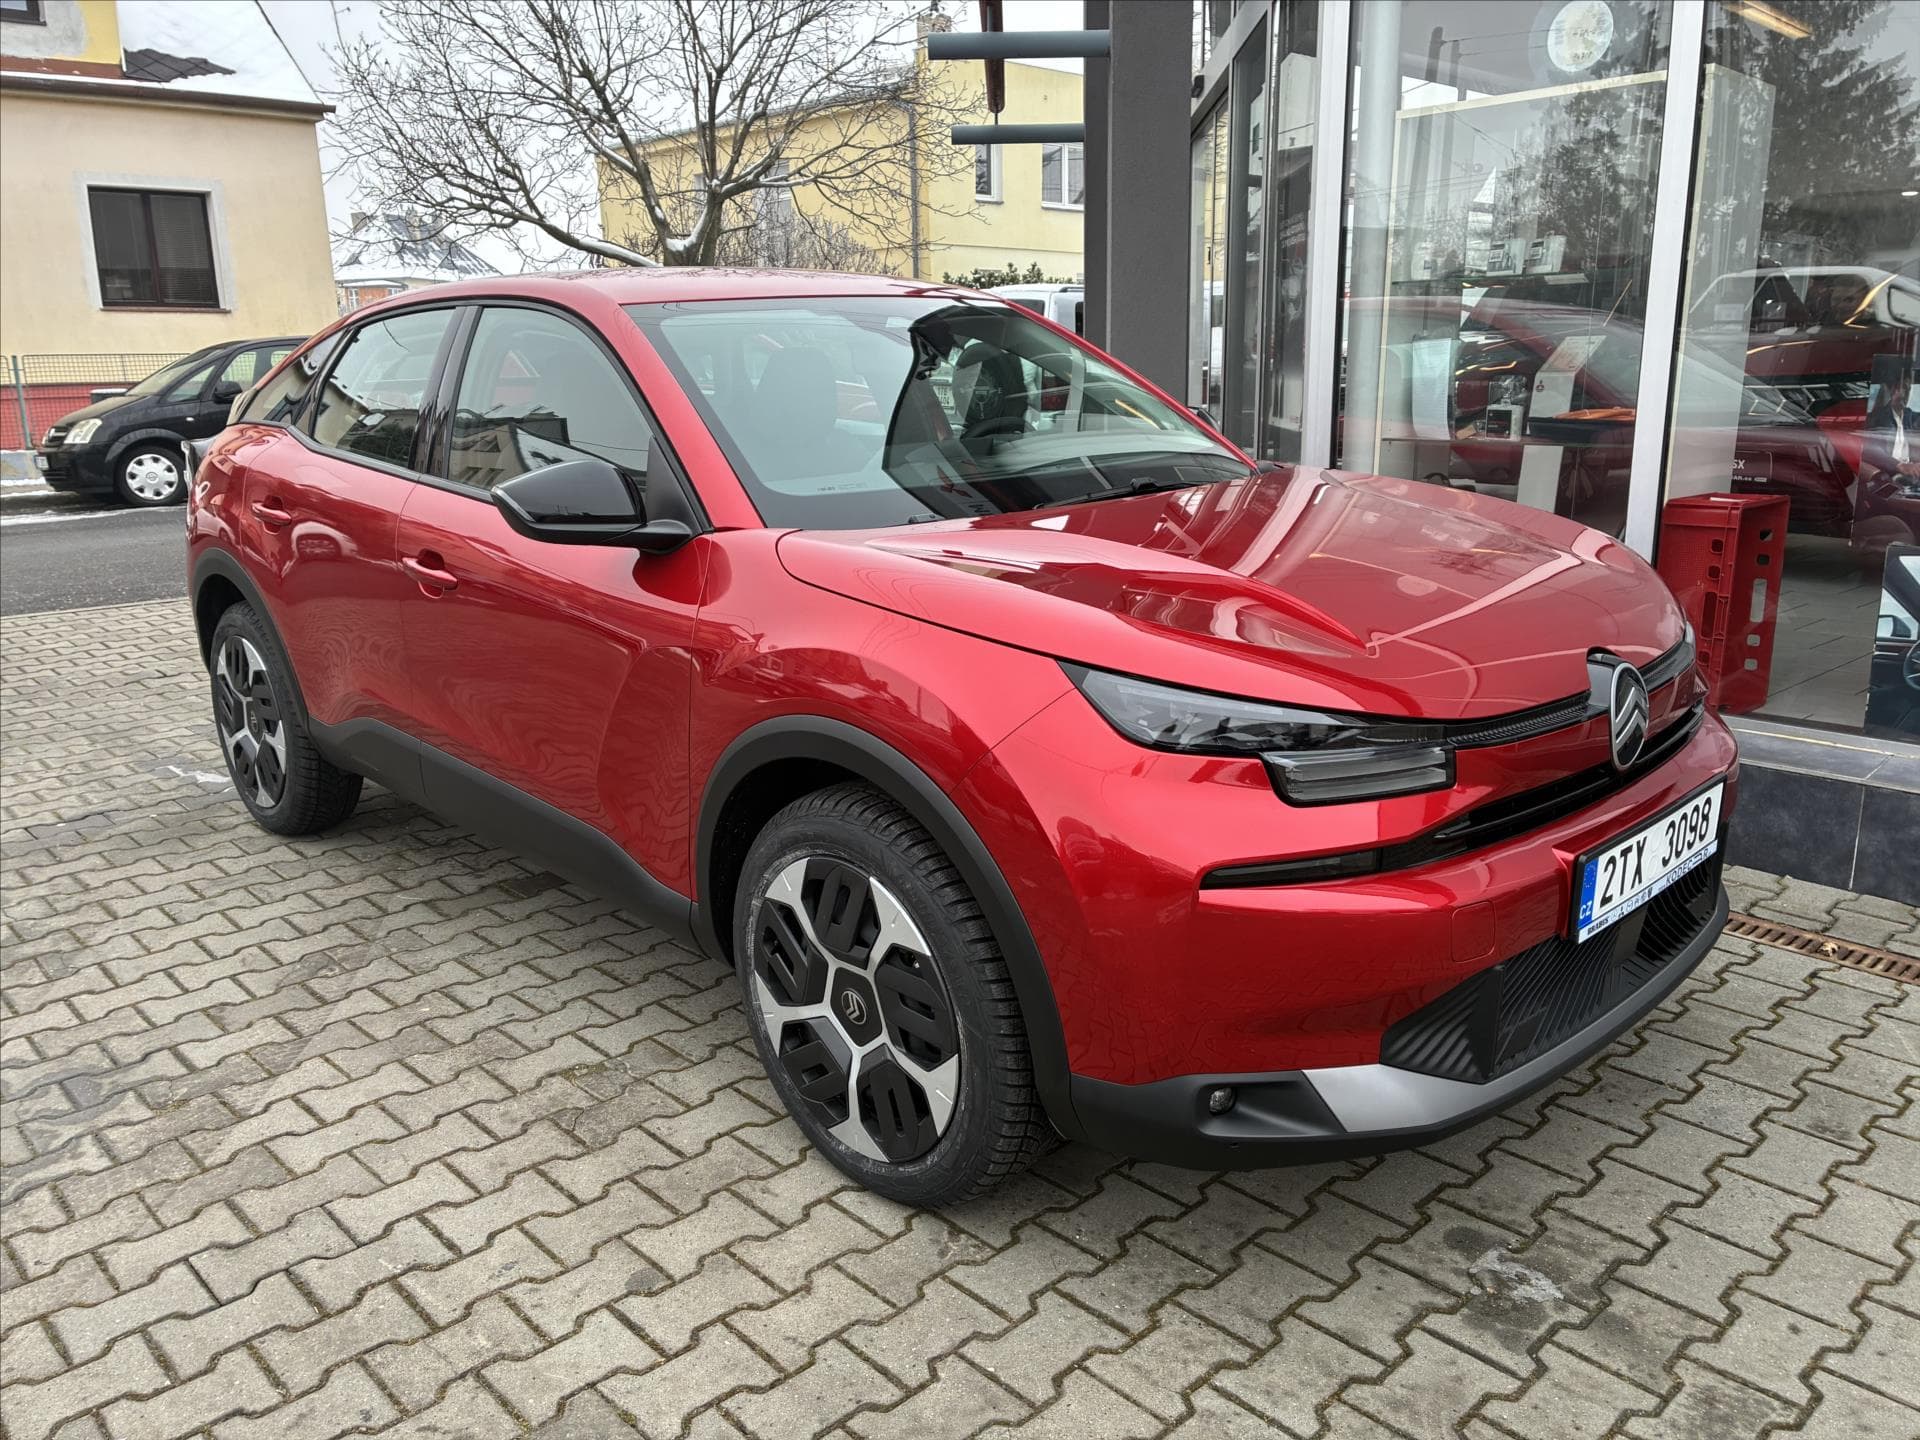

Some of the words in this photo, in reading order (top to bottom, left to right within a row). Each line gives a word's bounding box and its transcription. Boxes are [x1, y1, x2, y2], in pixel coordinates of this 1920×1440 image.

[1600, 836, 1647, 908] 2TX
[1662, 797, 1712, 867] 3098
[1580, 900, 1592, 920] CZ
